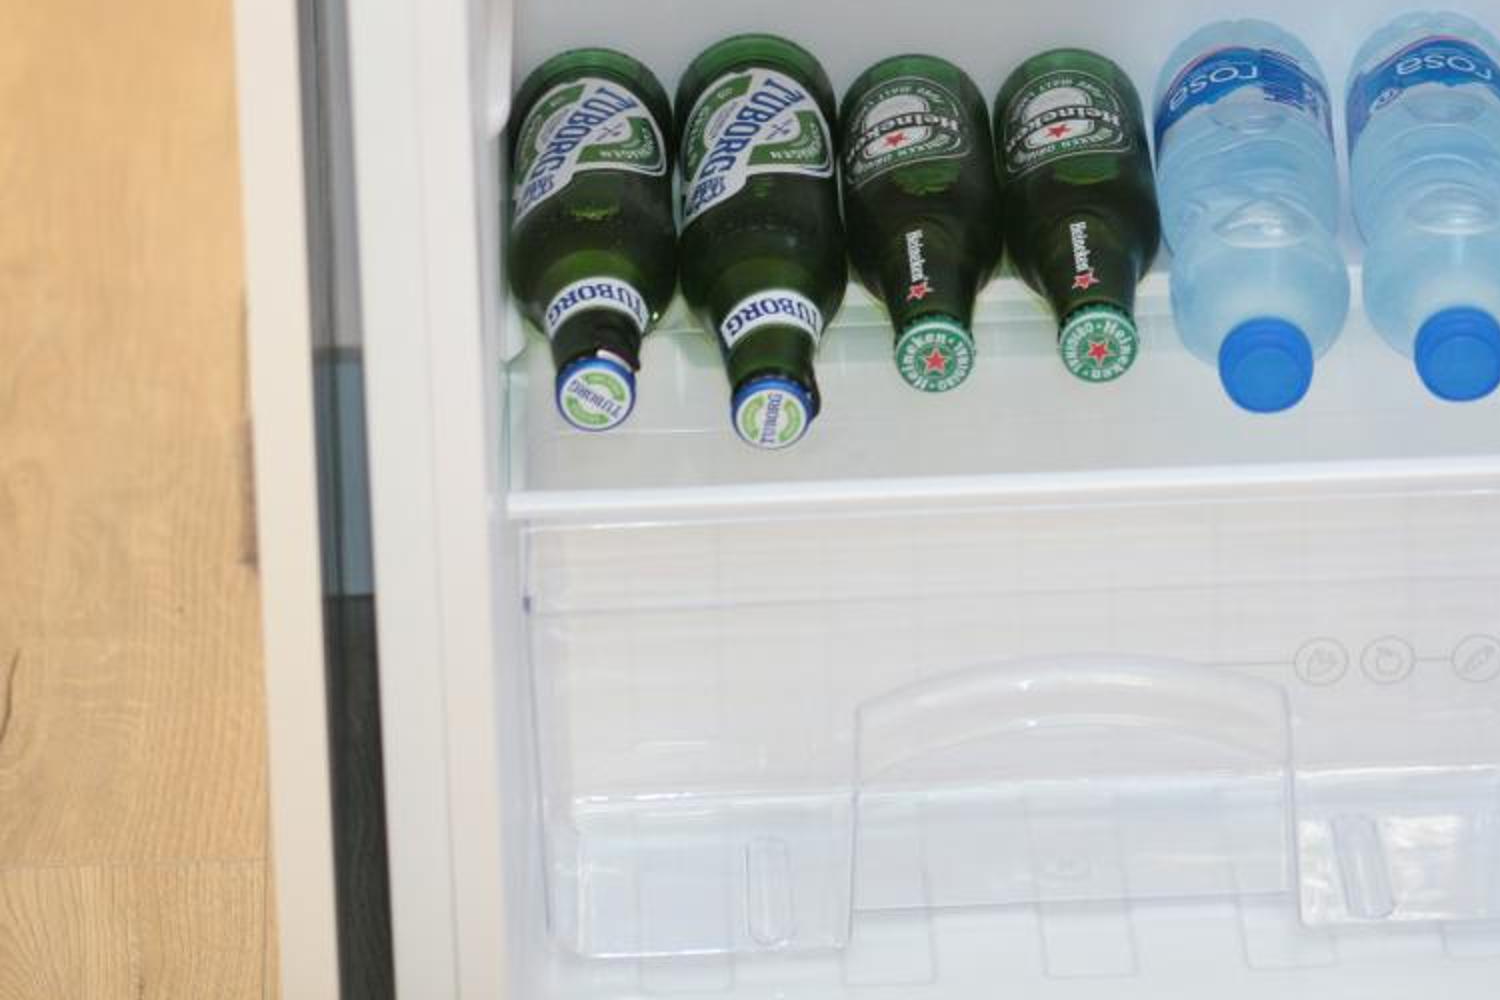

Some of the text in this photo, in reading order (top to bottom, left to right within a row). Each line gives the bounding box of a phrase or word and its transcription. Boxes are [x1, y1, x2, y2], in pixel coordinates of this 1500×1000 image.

[530, 87, 639, 180] TUBORG
[699, 78, 805, 179] TUBORG
[547, 283, 643, 326] TUBORG
